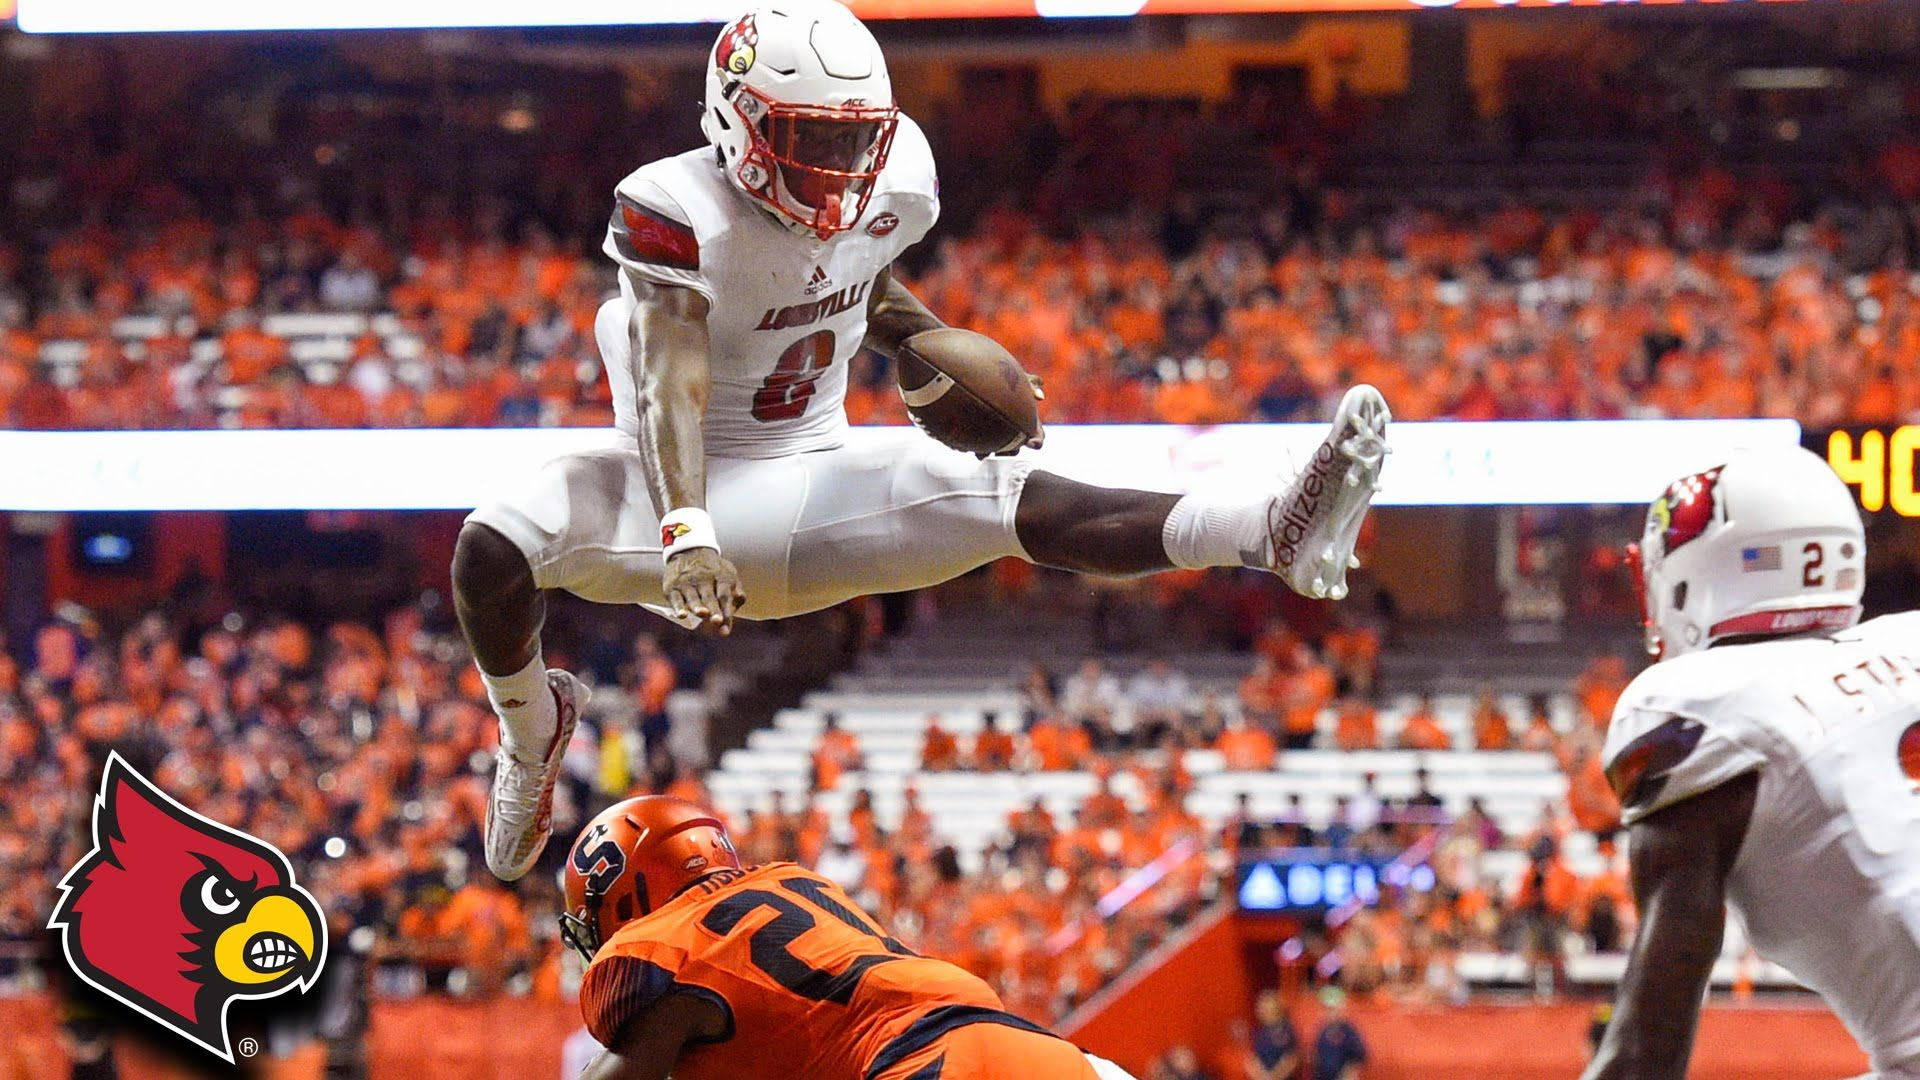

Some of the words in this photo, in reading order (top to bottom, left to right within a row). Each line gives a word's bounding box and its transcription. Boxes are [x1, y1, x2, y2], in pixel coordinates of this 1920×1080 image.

[868, 216, 898, 233] ACC
[1277, 441, 1334, 567] adizero
[1803, 542, 1824, 587] 2
